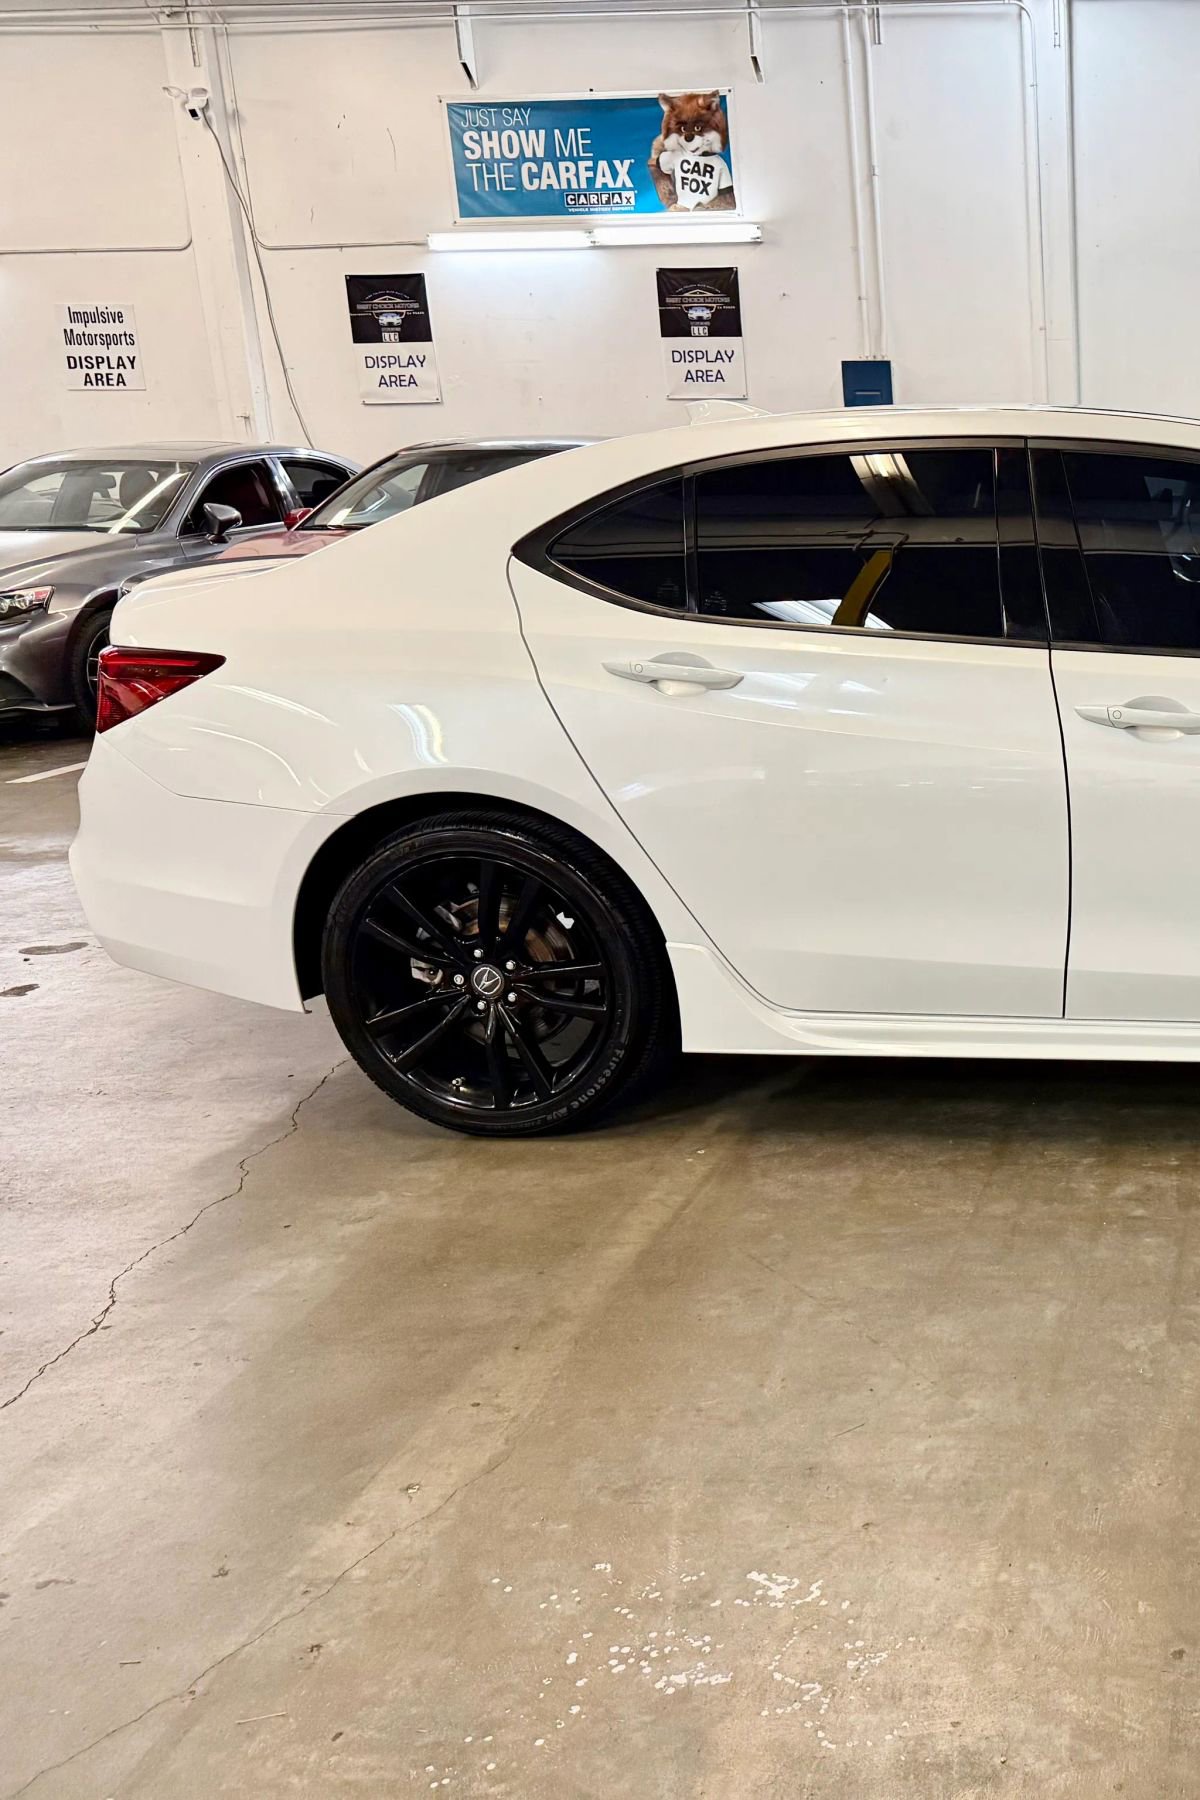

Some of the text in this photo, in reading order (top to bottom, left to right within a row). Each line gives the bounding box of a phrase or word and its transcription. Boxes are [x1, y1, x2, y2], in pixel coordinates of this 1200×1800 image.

[461, 107, 531, 128] JUST SAY
[463, 128, 593, 160] SHOW ME
[465, 158, 634, 192] THE CARFAX
[680, 159, 714, 179] CAR
[681, 176, 713, 196] FOX
[565, 192, 634, 206] CARFAX
[67, 306, 124, 328] Impulsive
[383, 332, 399, 342] LLC
[691, 326, 708, 336] LLC
[63, 328, 135, 350] Motorsports
[66, 355, 136, 369] DISPLAY
[364, 354, 426, 369] DISPLAY
[671, 349, 735, 363] DISPLAY
[83, 372, 127, 387] AREA
[378, 374, 418, 388] AREA
[684, 369, 725, 383] AREA
[570, 1048, 625, 1109] Firestone
